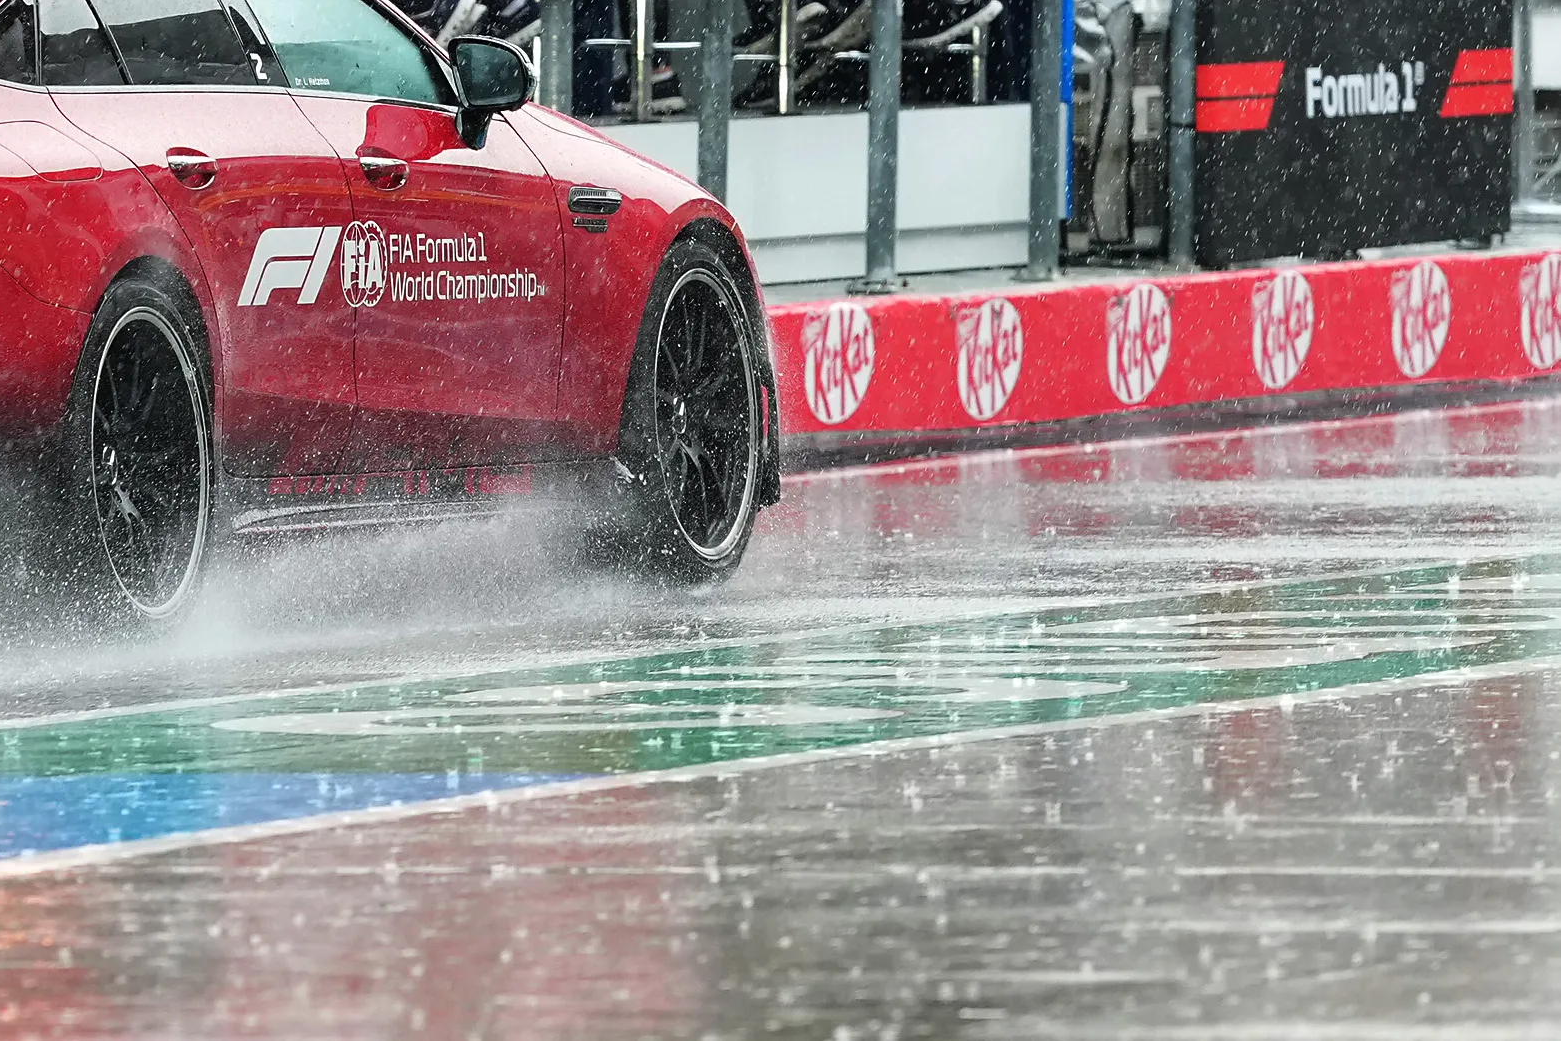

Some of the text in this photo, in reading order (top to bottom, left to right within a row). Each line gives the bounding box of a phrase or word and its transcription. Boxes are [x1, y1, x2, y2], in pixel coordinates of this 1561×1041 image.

[249, 52, 268, 80] 2
[1305, 61, 1399, 119] Formula
[389, 231, 488, 264] FIA Formula 1
[390, 270, 437, 302] World
[812, 306, 871, 421] KitKat
[965, 301, 1019, 417] KitKat
[1115, 287, 1167, 401] KitKat
